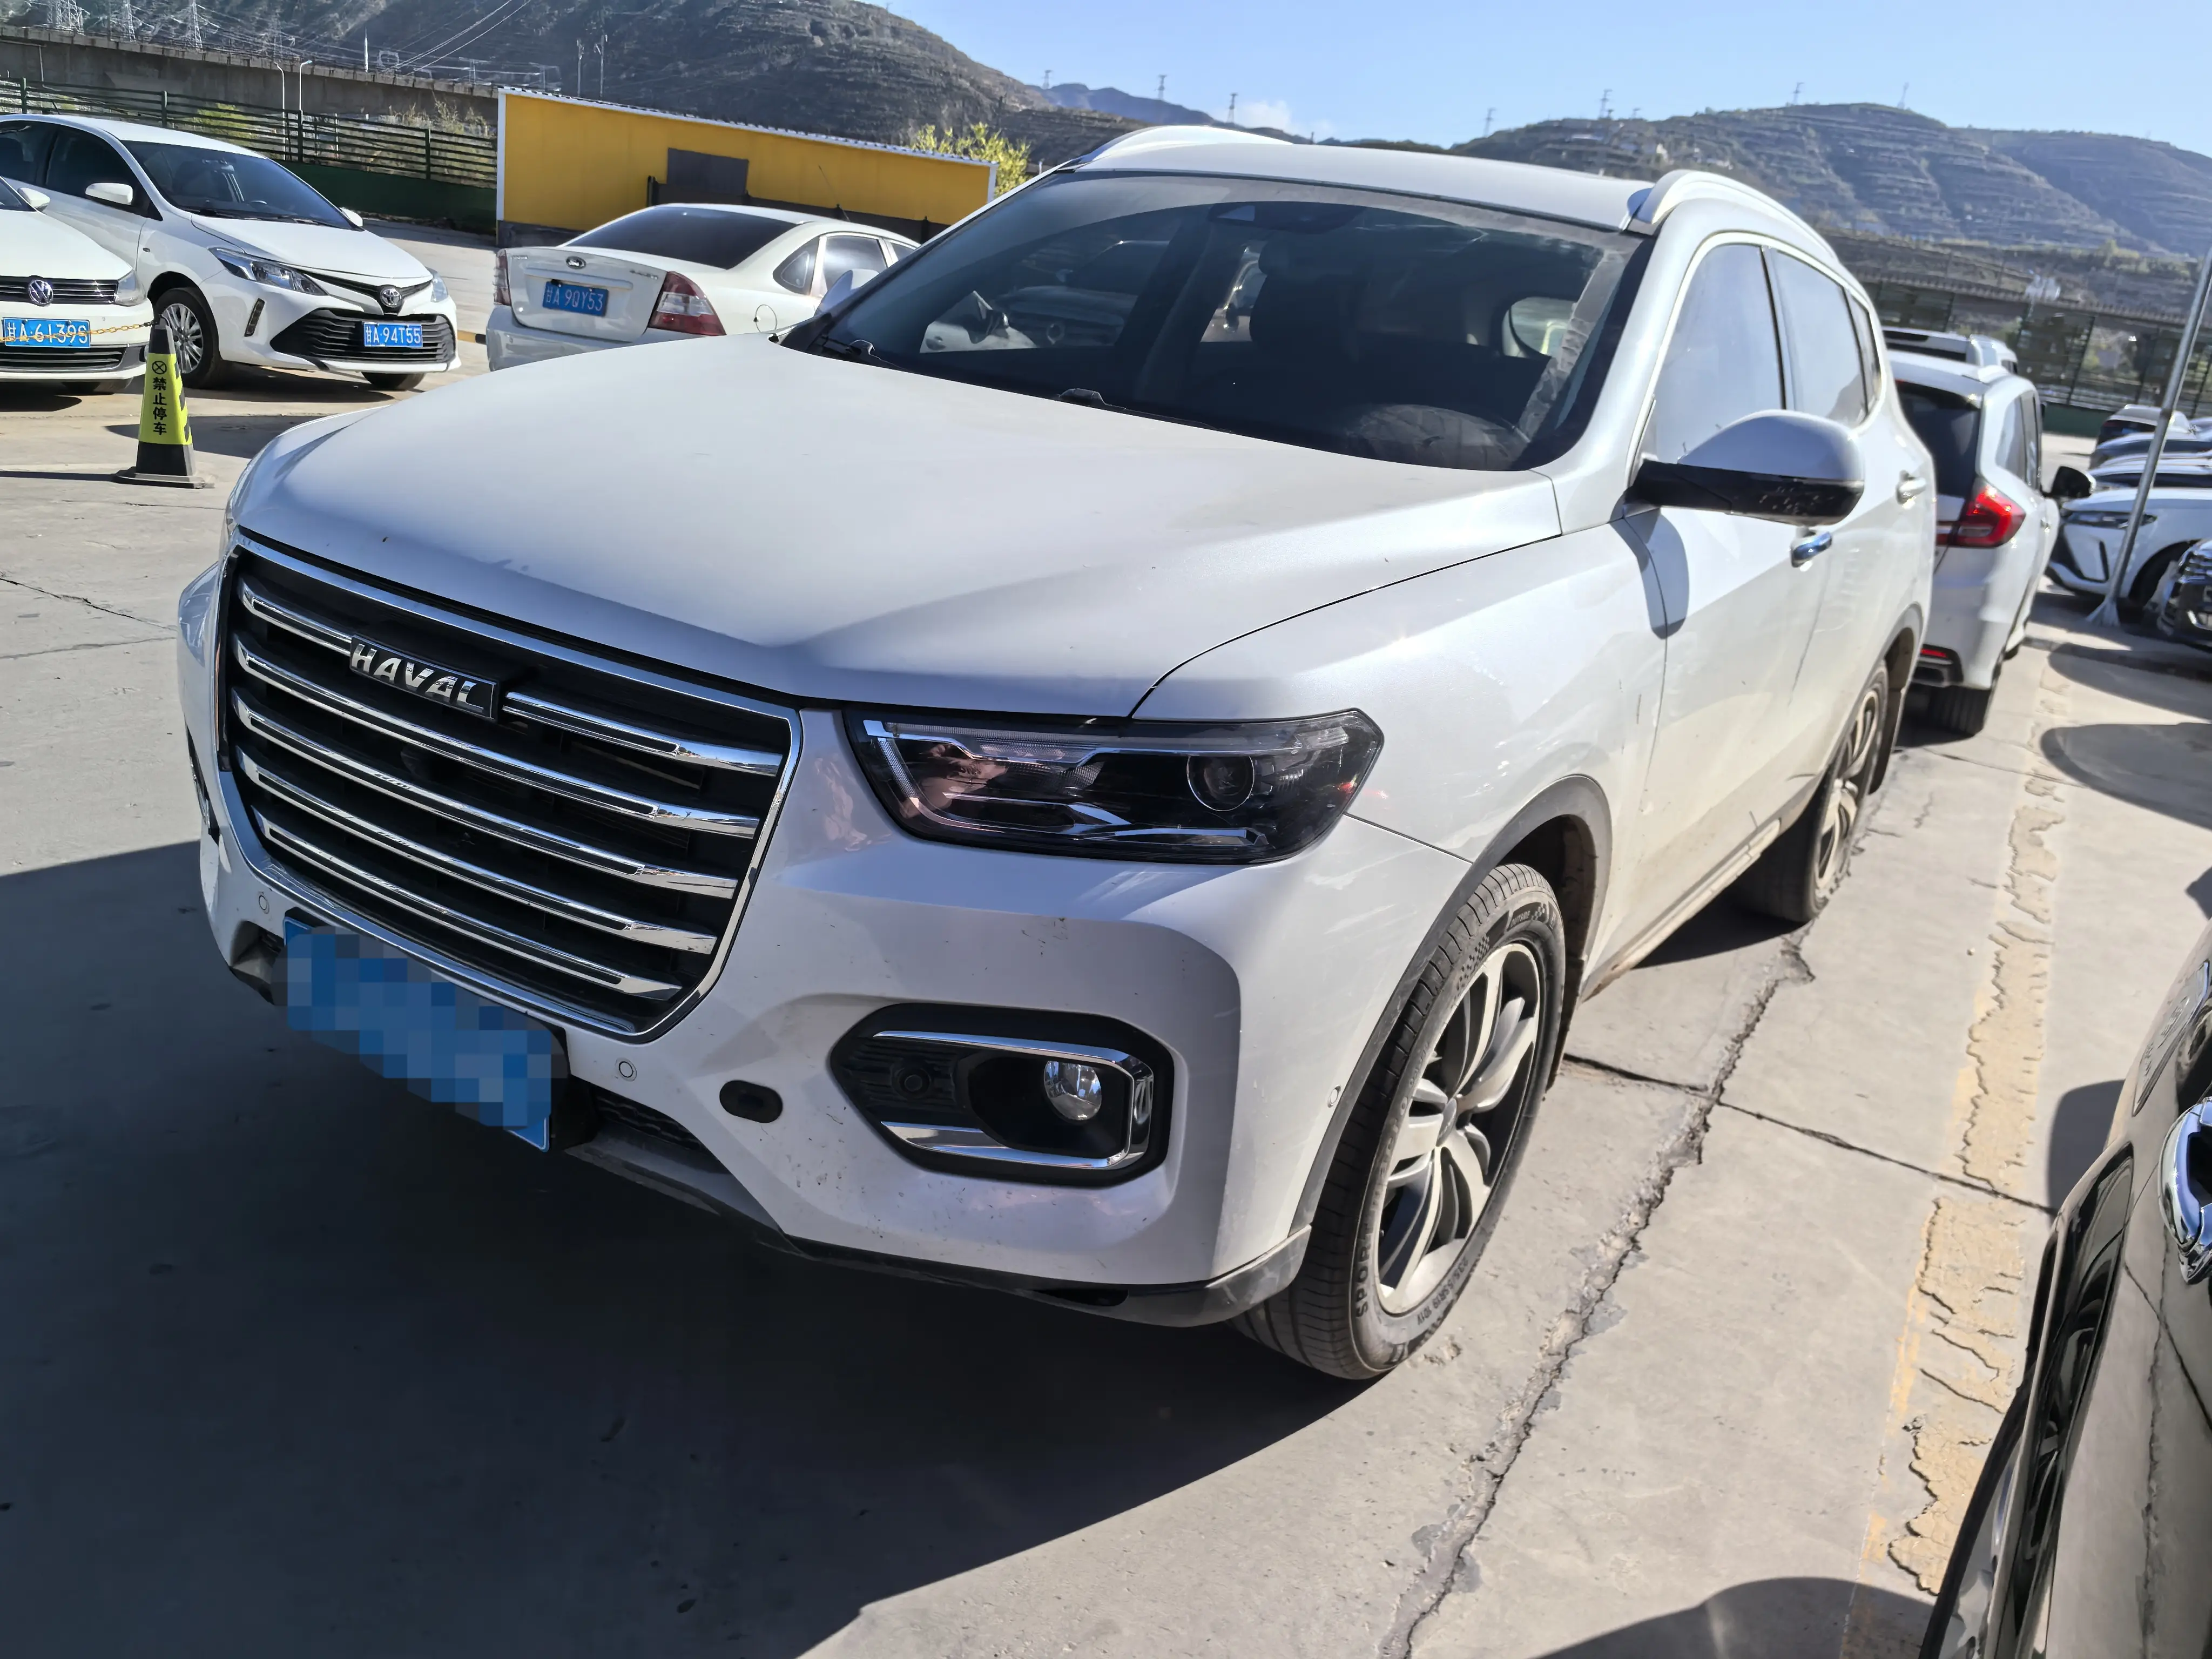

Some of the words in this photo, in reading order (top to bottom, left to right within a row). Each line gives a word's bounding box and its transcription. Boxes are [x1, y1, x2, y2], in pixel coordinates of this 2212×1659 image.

[152, 377, 167, 435] 禁止停车
[351, 643, 484, 713] HAVAL
